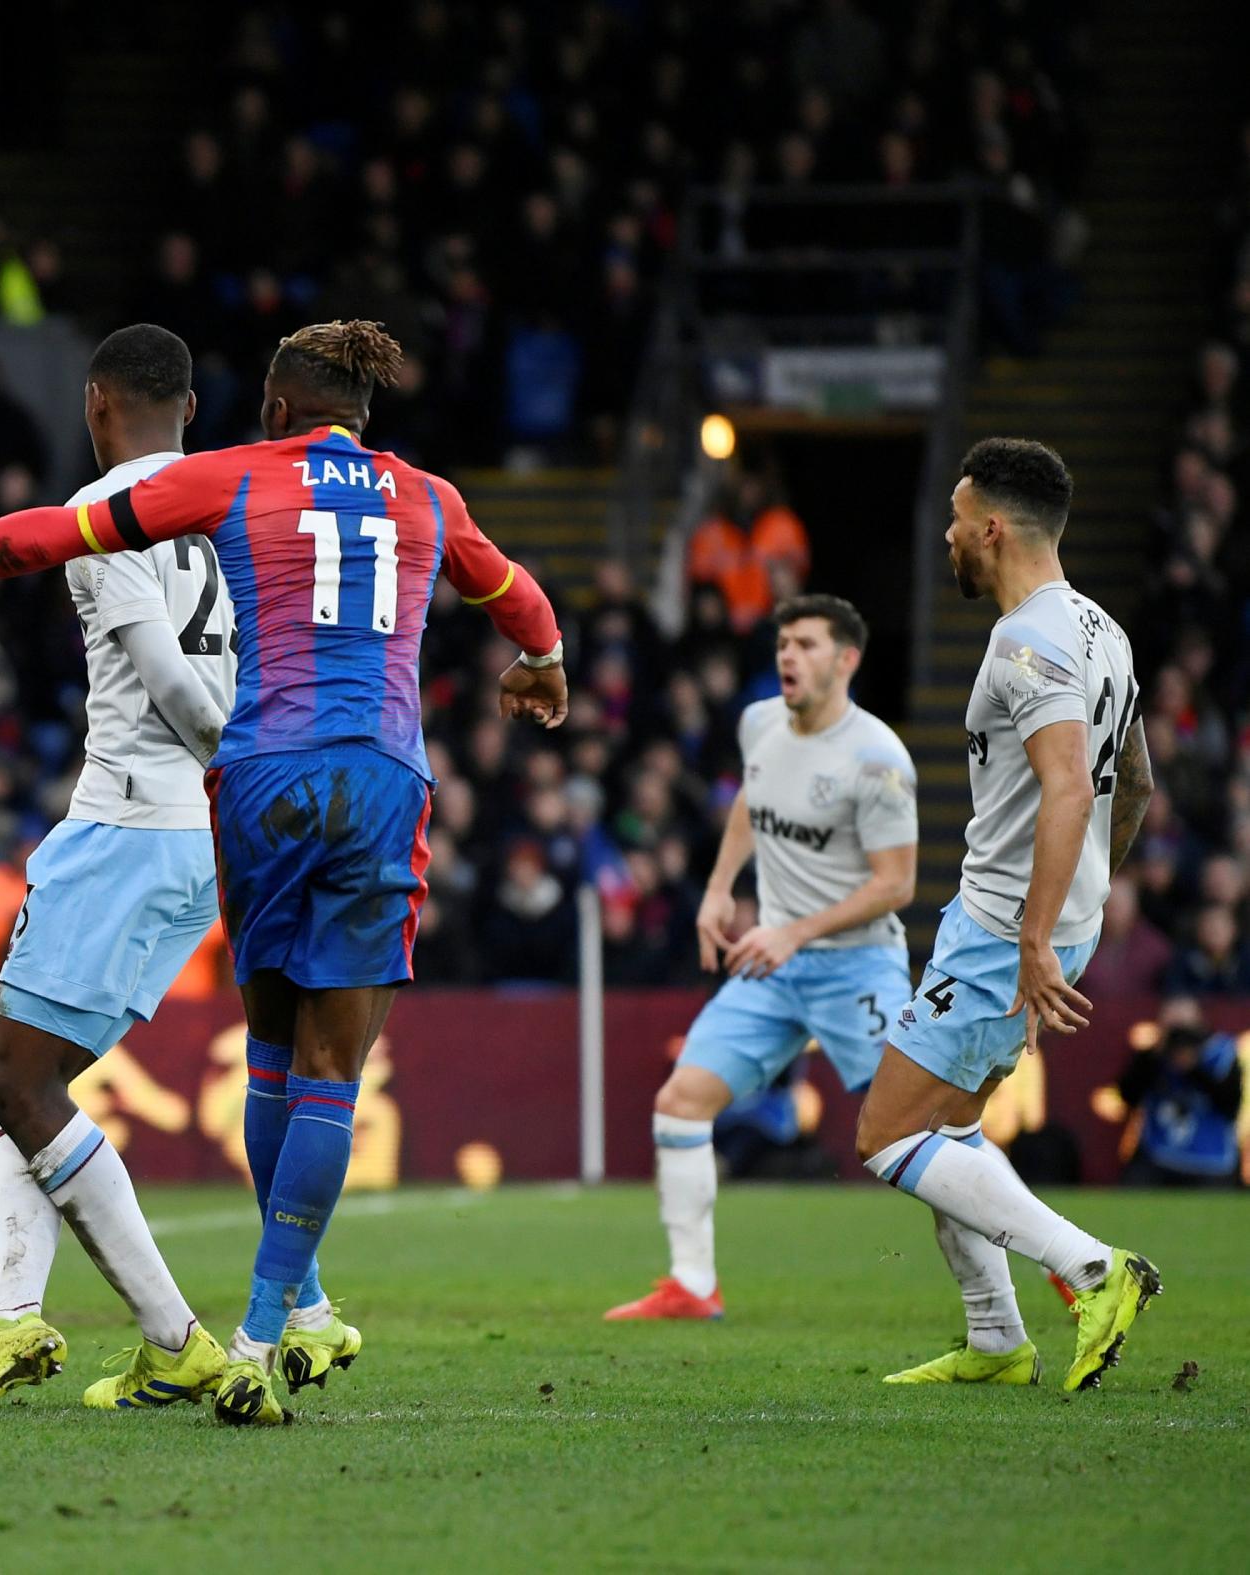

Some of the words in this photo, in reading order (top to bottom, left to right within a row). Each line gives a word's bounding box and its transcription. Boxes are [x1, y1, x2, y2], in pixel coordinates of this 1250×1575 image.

[292, 459, 397, 499] ZAHA
[297, 509, 399, 634] 11
[174, 534, 238, 656] 2
[749, 806, 834, 853] etway
[858, 993, 888, 1037] 3
[922, 976, 958, 1019] 4
